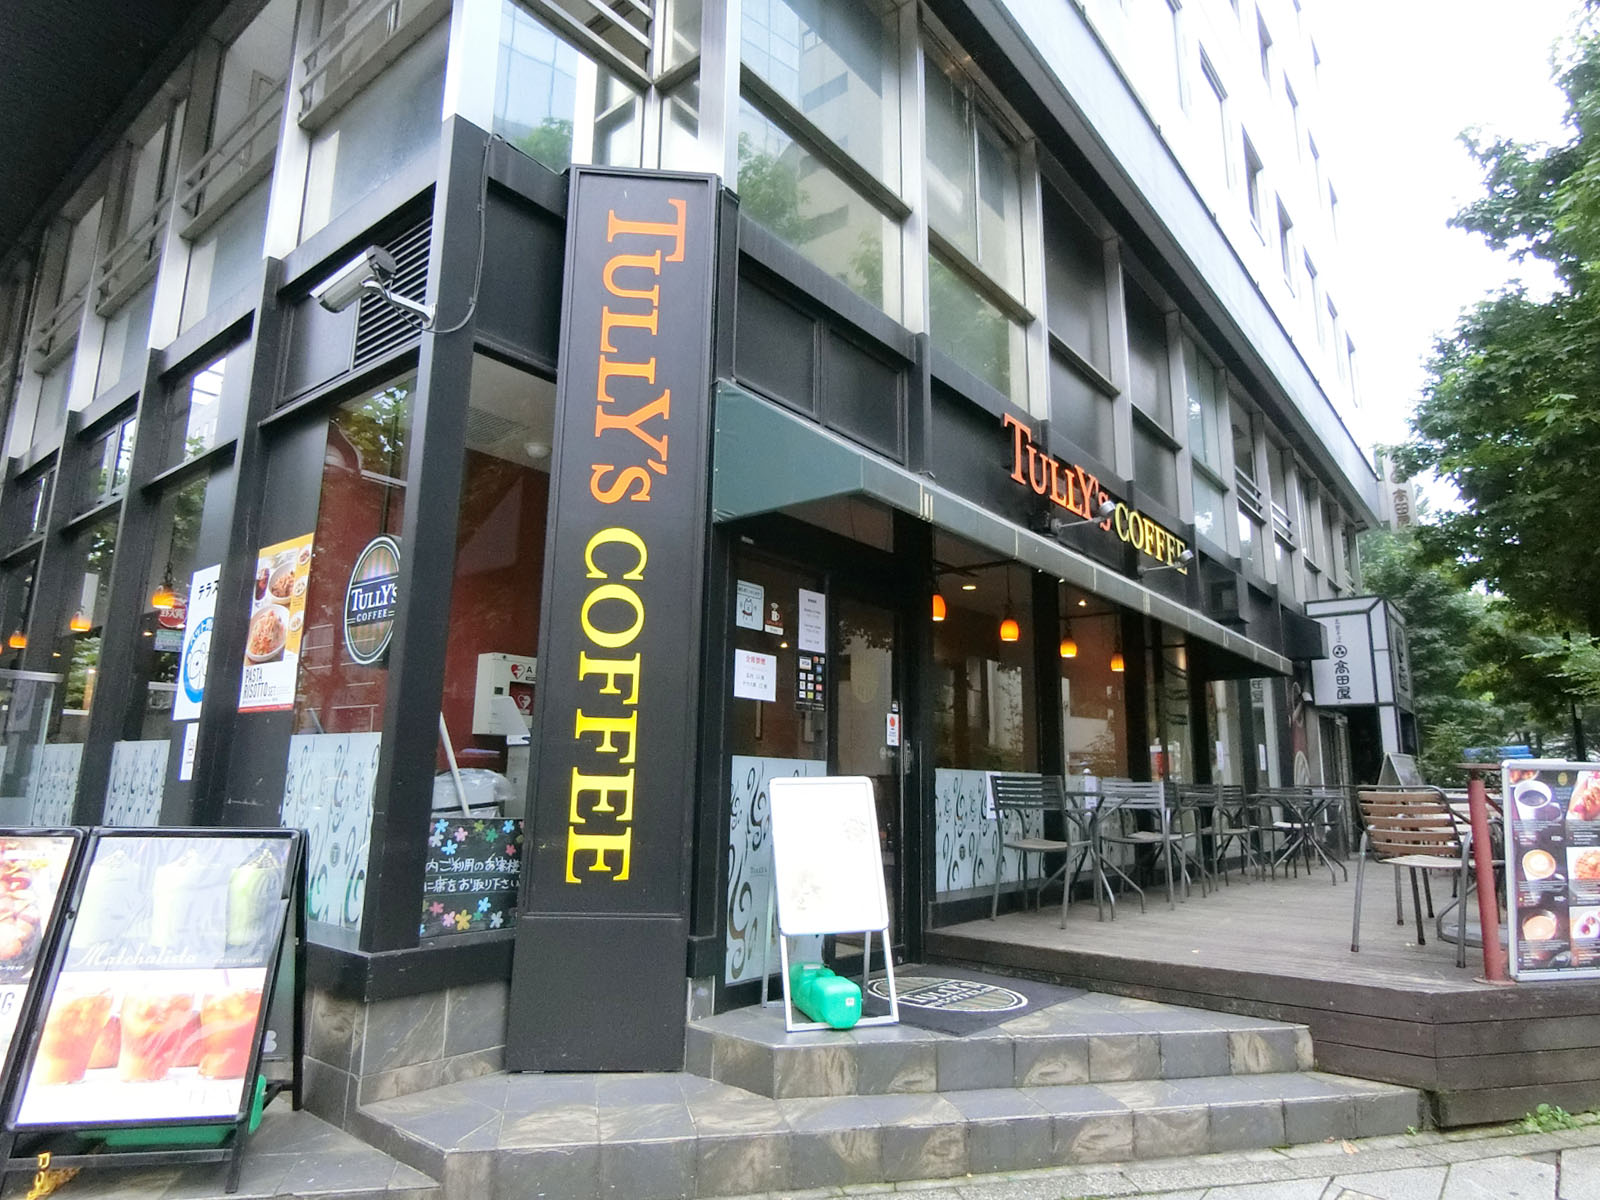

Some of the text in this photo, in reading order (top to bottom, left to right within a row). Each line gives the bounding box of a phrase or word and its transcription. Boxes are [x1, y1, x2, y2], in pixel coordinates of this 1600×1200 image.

[1115, 502, 1188, 576] COFFEE
[356, 609, 388, 623] COFFEE
[245, 667, 263, 684] PASTA
[243, 681, 269, 699] RISOTTO
[565, 527, 648, 884] COFFEE
